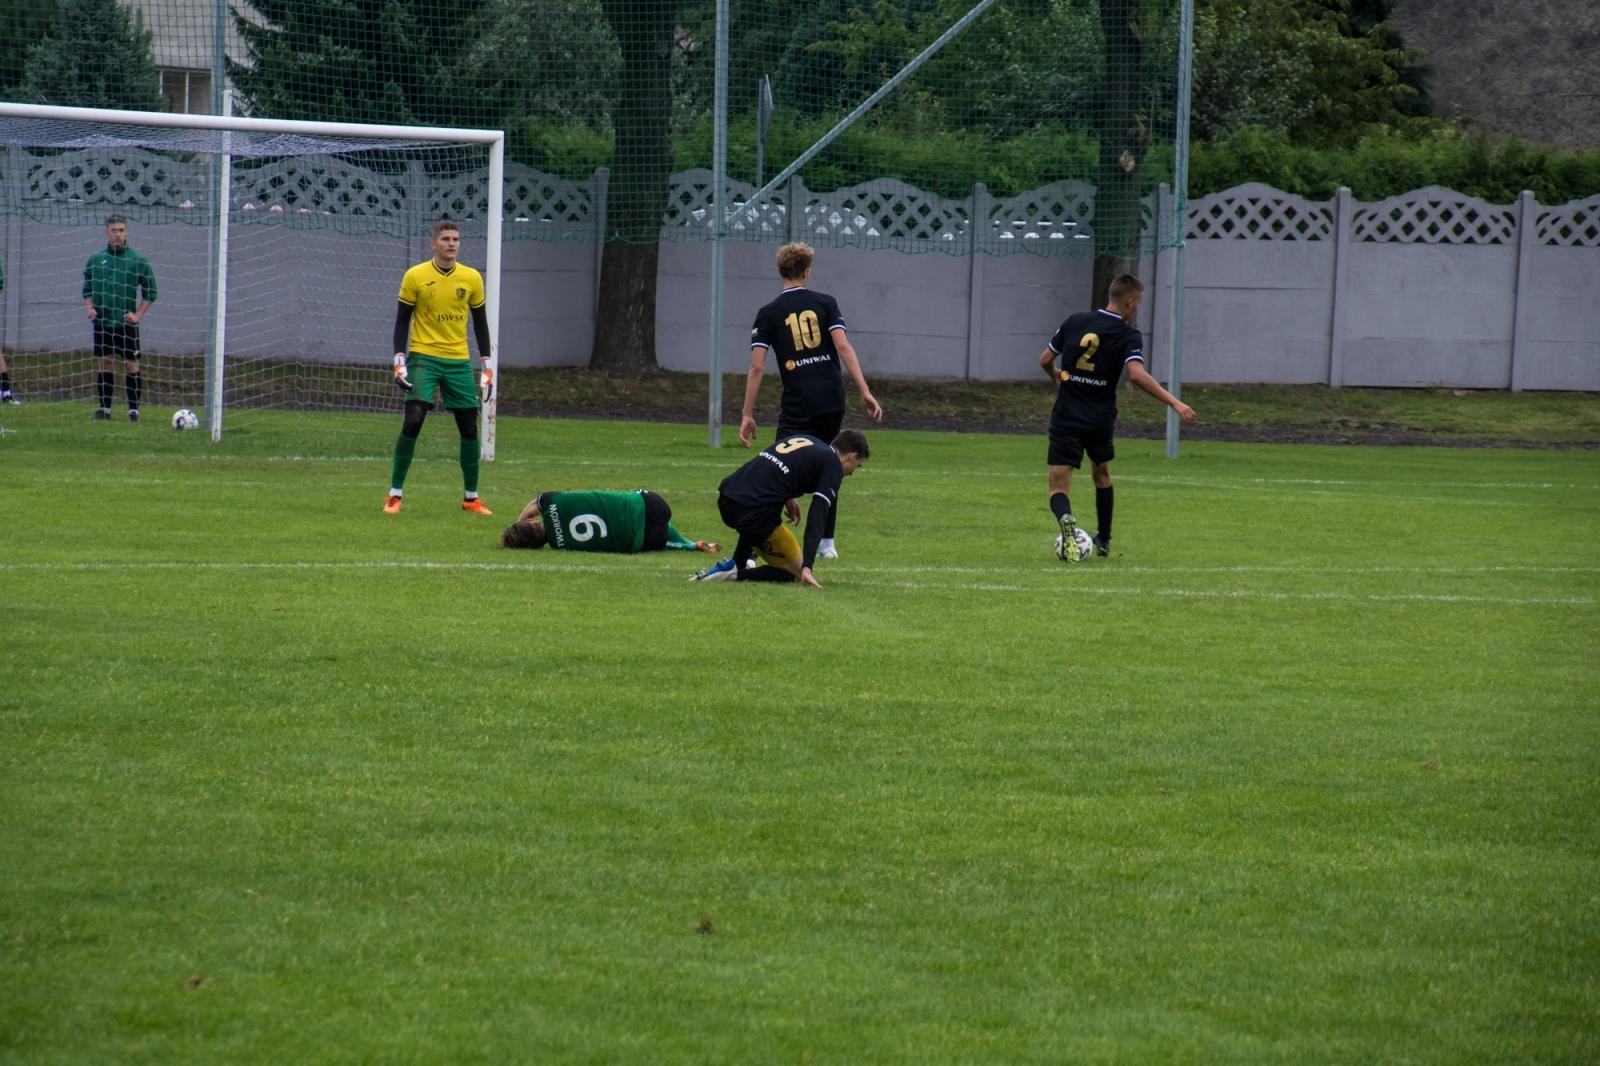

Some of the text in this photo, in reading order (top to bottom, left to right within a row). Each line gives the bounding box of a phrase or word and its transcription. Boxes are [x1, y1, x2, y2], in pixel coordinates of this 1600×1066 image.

[785, 310, 822, 351] 10
[1076, 332, 1100, 372] 2
[775, 437, 815, 454] 9
[569, 513, 608, 542] 9
